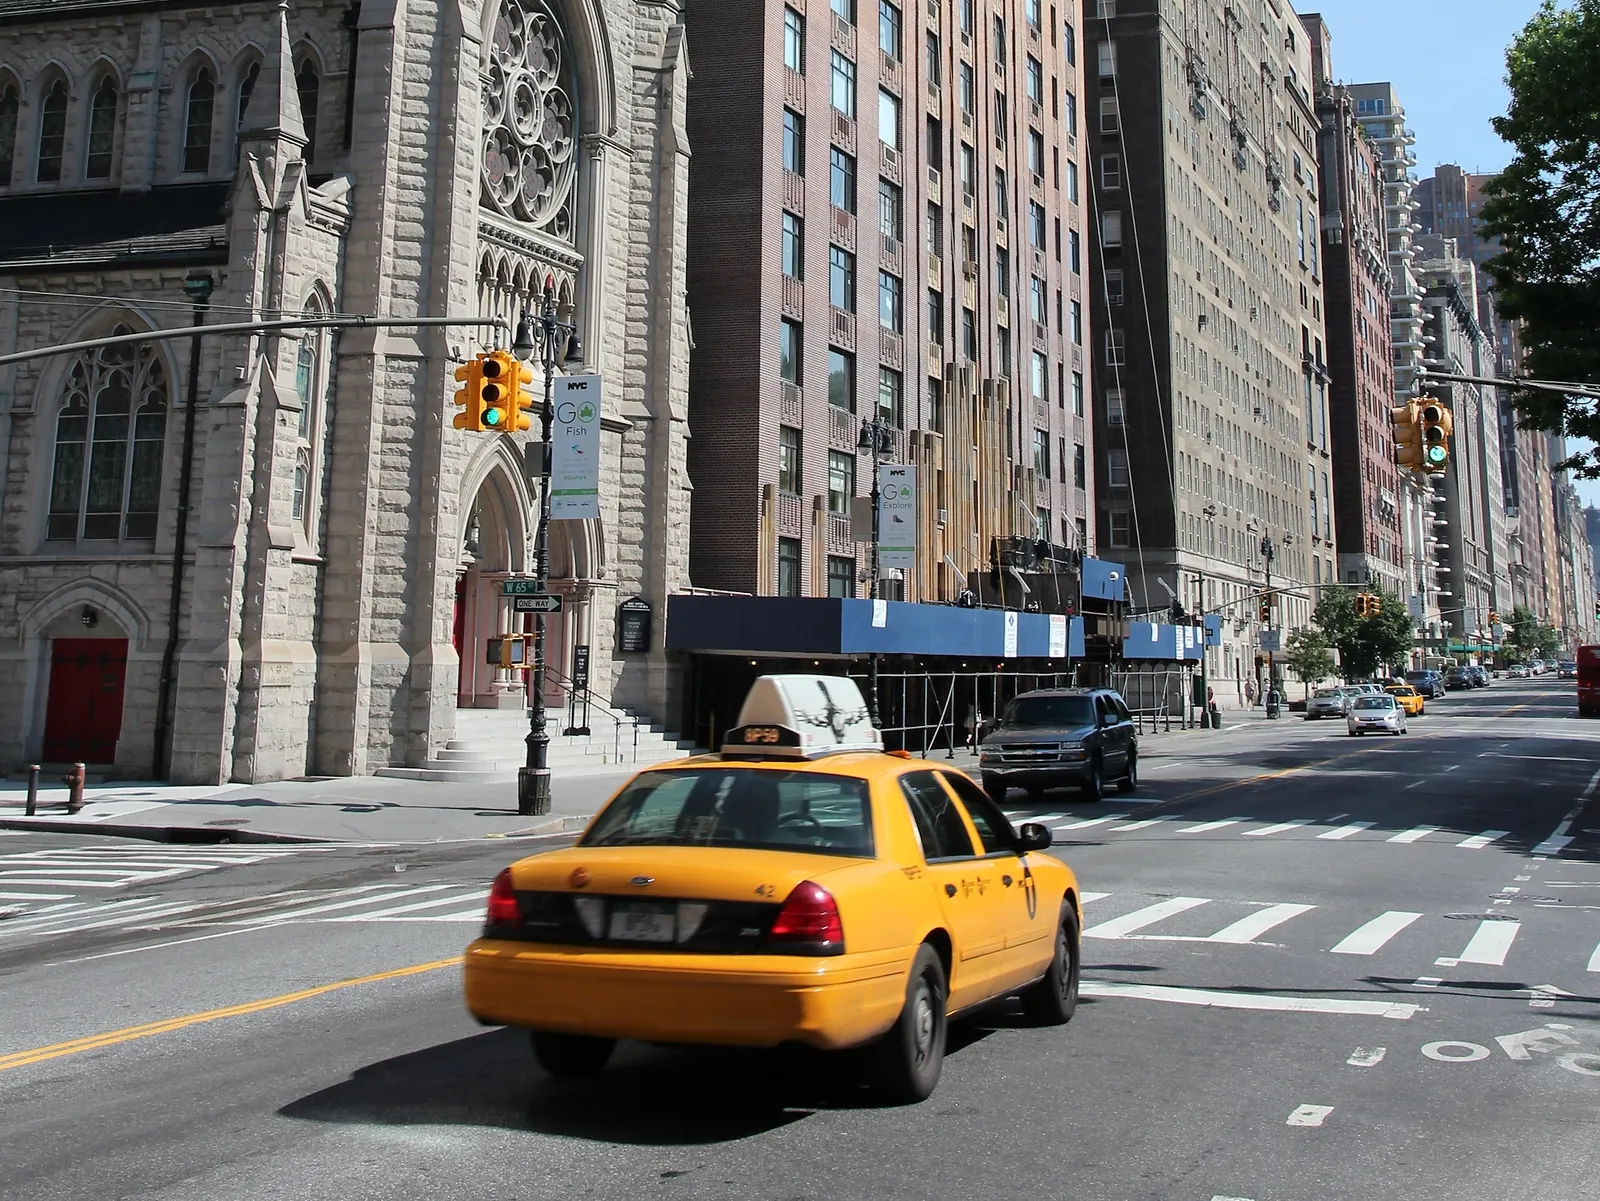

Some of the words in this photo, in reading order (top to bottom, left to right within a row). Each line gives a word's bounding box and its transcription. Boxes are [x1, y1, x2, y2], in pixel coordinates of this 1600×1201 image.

[567, 382, 588, 391] NYC
[566, 426, 587, 436] Fish
[883, 502, 912, 510] Explore
[506, 582, 514, 593] W
[515, 582, 527, 593] 65
[518, 600, 532, 608] ONE
[535, 600, 549, 608] WAY
[755, 883, 774, 898] 42
